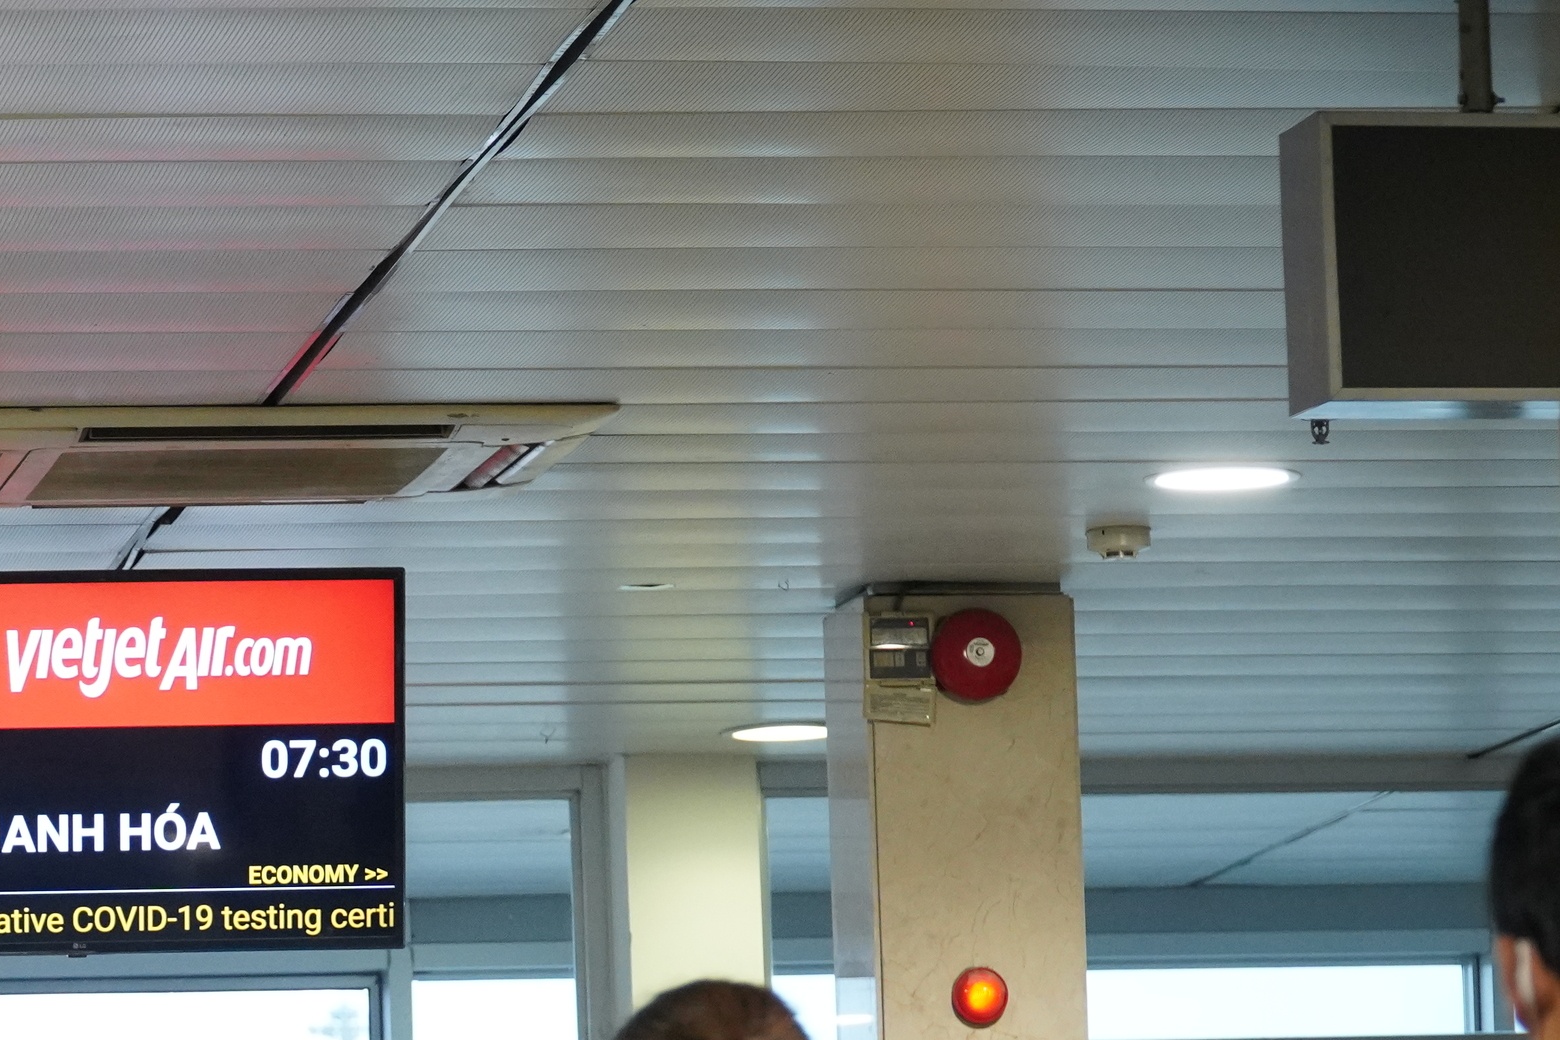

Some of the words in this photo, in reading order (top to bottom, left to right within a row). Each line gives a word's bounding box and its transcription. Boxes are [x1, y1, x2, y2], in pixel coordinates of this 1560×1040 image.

[261, 738, 387, 779] 07:30
[119, 802, 222, 852] HÓA
[248, 863, 360, 885] ECONOMY
[72, 904, 214, 933] COVID-19
[220, 903, 322, 936] testing
